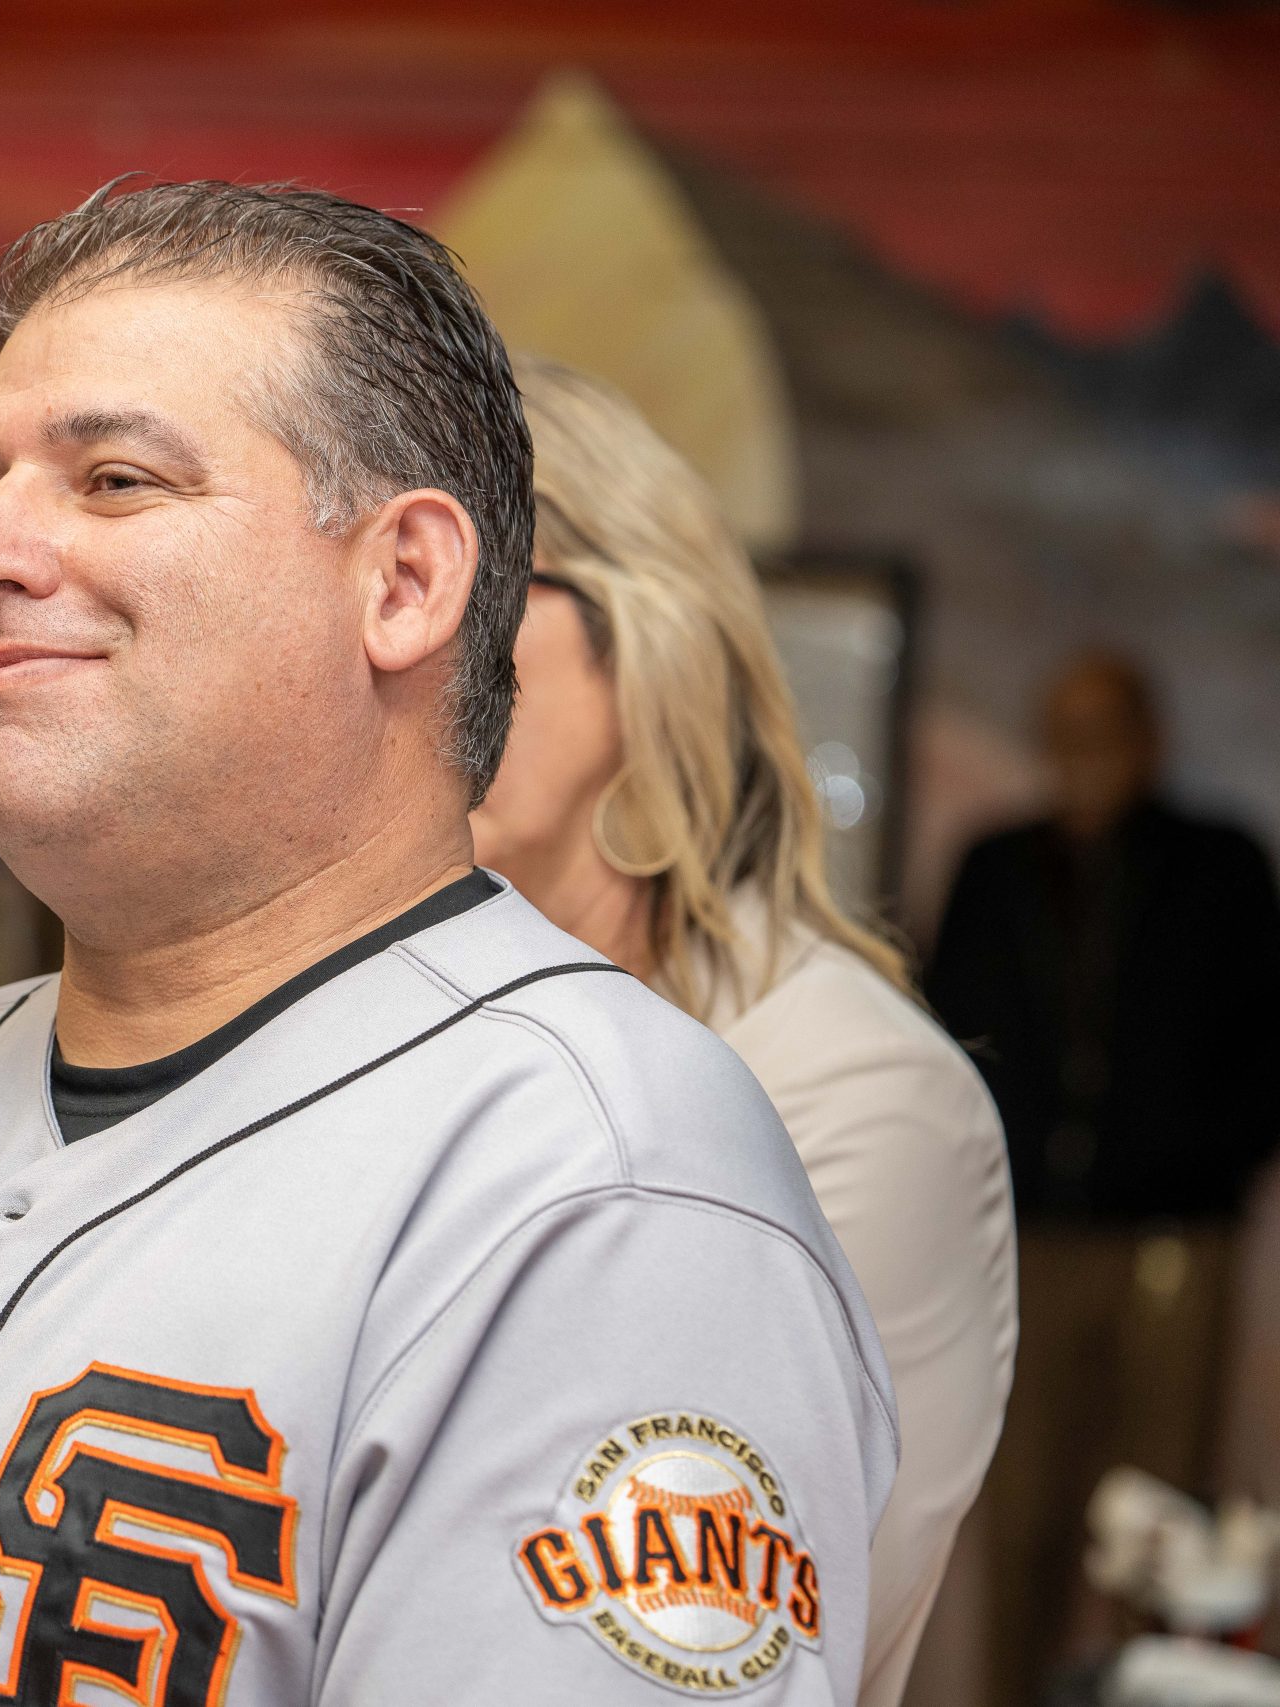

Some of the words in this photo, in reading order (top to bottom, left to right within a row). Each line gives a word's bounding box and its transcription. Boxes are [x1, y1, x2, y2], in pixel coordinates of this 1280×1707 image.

[573, 1438, 628, 1503] SAN
[627, 1412, 786, 1518] FRANCISCO
[519, 1502, 820, 1639] GIANTS
[590, 1608, 739, 1692] BASEBALL
[739, 1624, 792, 1682] CLUB
